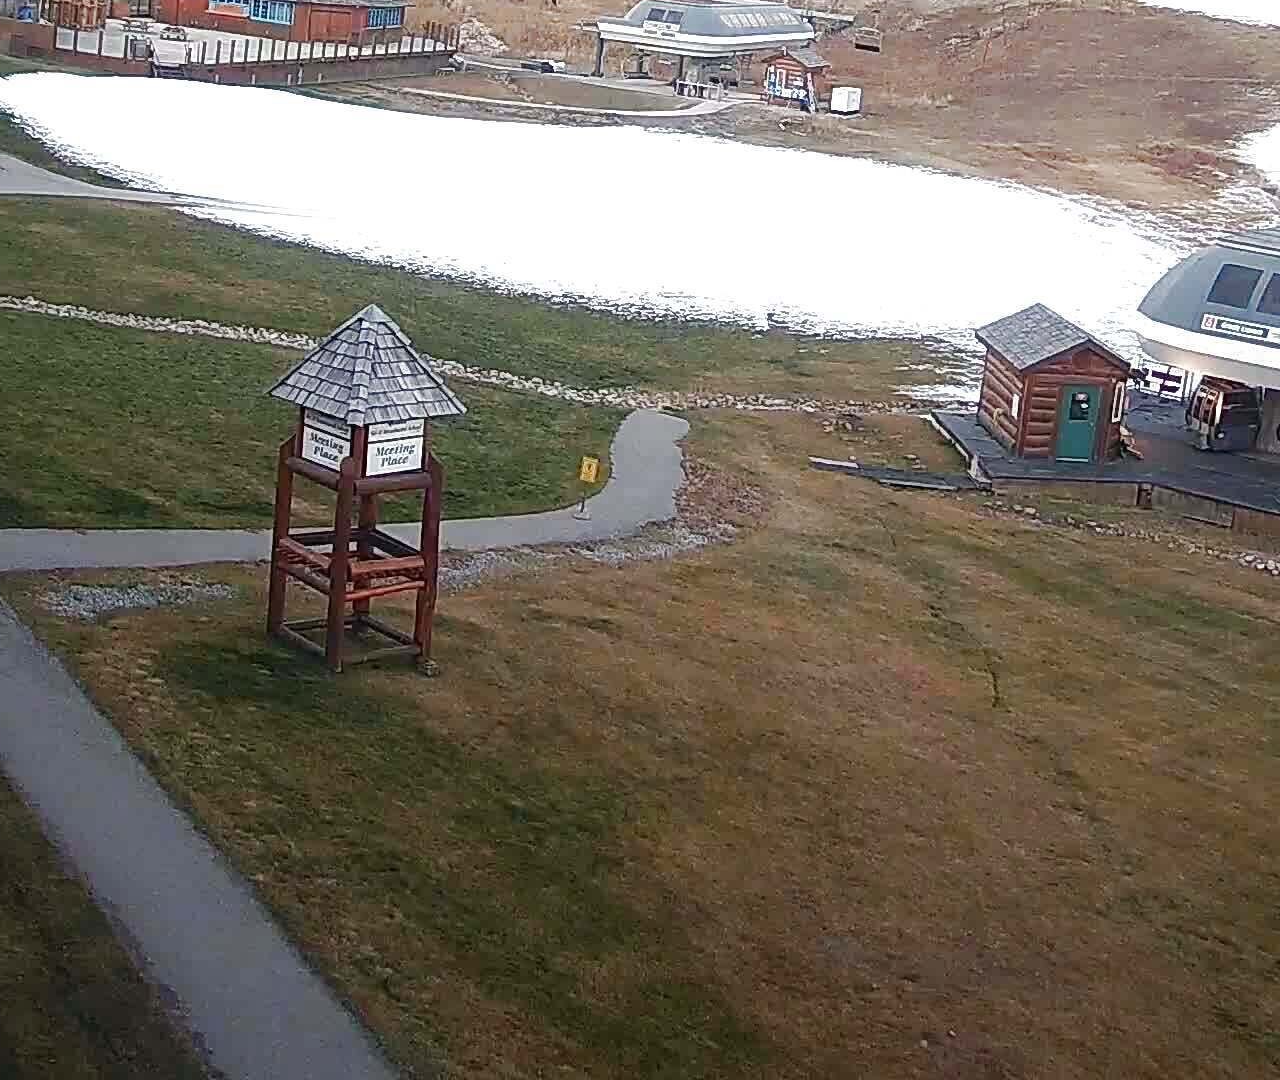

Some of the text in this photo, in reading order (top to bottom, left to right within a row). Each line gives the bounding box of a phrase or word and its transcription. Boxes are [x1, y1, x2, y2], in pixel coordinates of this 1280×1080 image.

[309, 432, 344, 454] Meeting
[375, 443, 416, 457] Meeting
[313, 446, 339, 462] Place
[380, 455, 409, 468] Place
